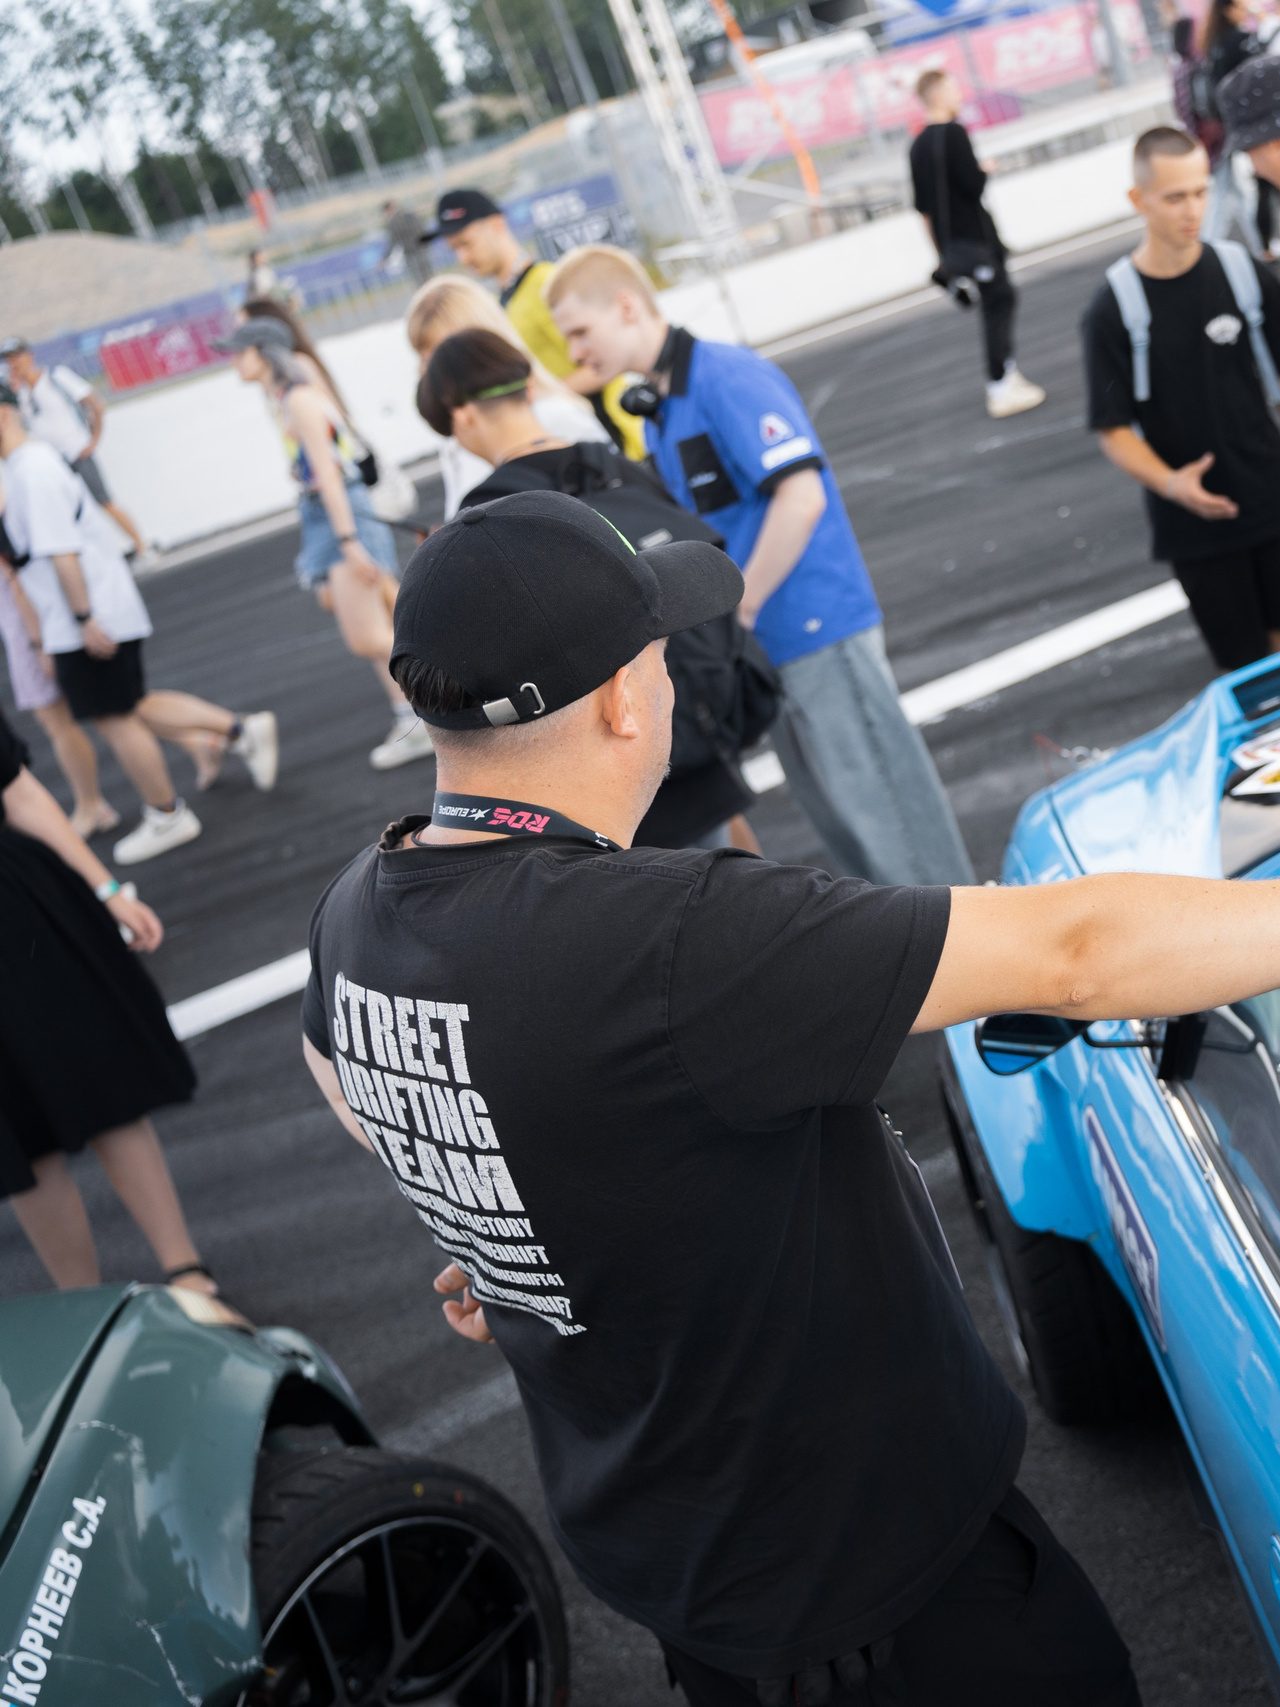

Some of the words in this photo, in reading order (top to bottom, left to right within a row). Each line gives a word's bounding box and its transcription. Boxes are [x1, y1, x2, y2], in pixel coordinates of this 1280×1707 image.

[438, 805, 468, 818] EUROPE
[486, 807, 550, 834] RDS
[333, 971, 471, 1084] STREET
[335, 1050, 501, 1150] DRIFTING
[351, 1110, 526, 1212] TEAM
[2, 1547, 83, 1707] КОРНЕЕВ
